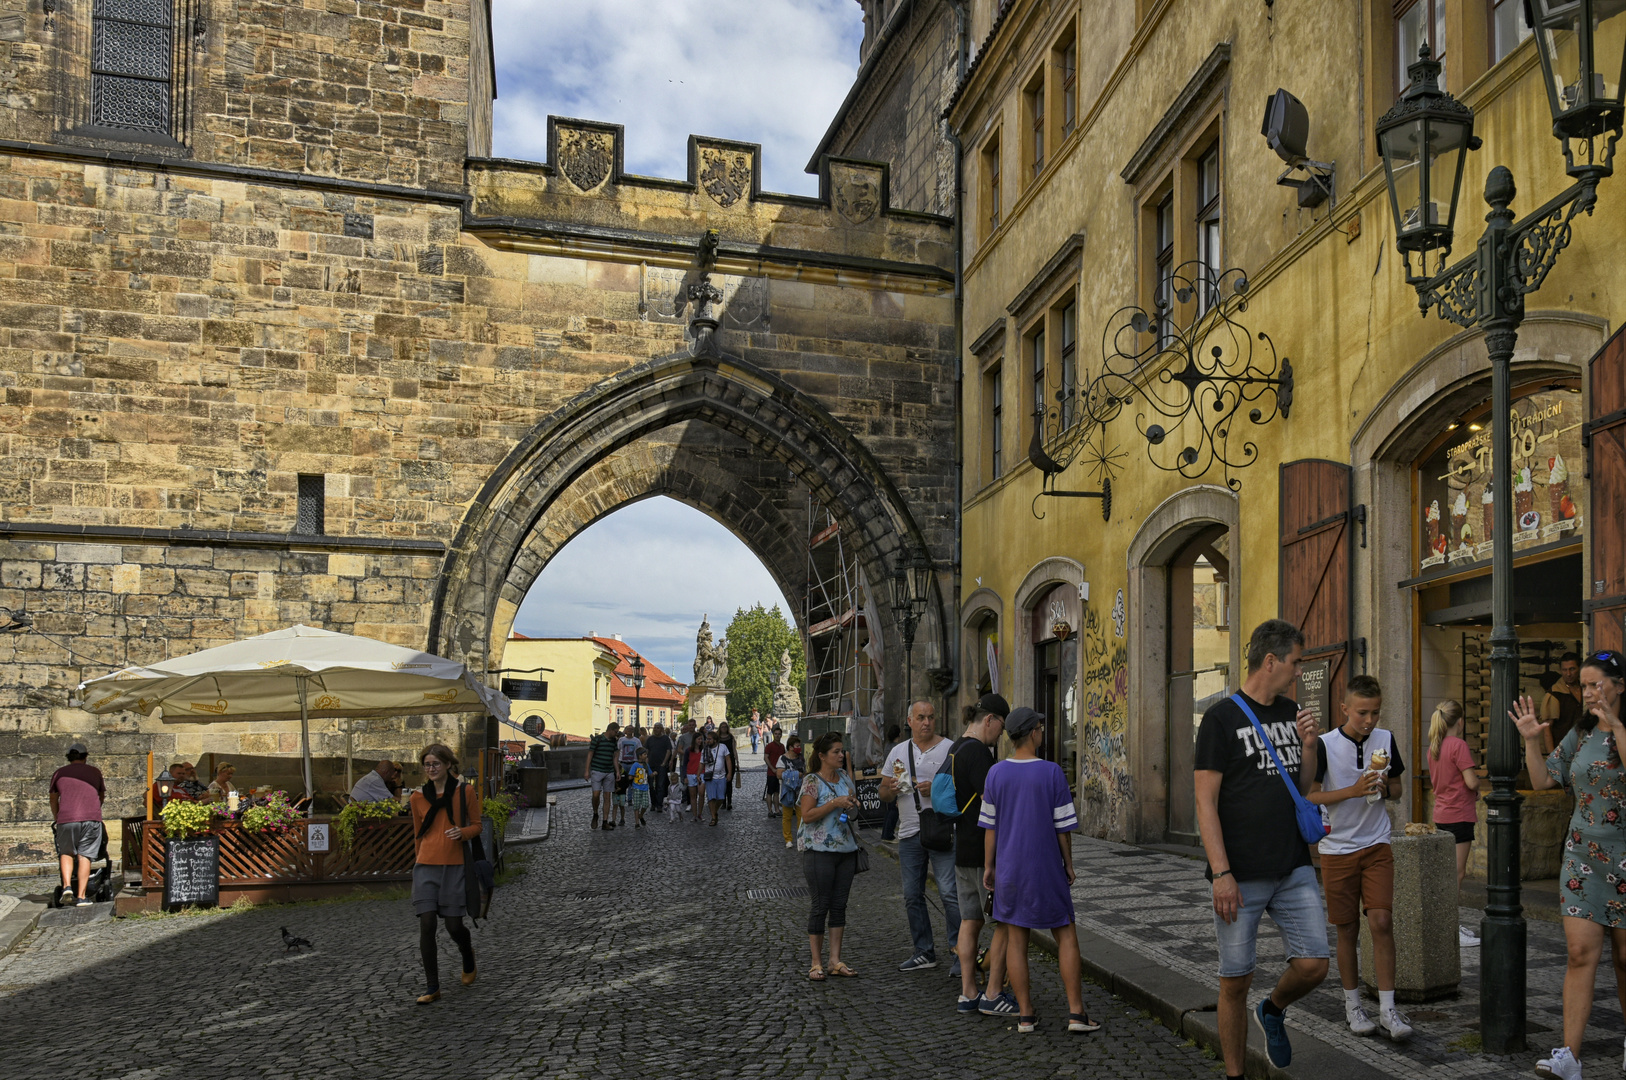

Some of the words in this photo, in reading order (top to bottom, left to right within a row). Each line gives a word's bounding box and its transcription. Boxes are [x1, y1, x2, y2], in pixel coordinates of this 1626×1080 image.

[1522, 400, 1562, 428] TRADIČNÍ
[1302, 669, 1324, 681] COFFEE
[860, 791, 879, 800] TOČEN
[863, 801, 880, 810] PIVO
